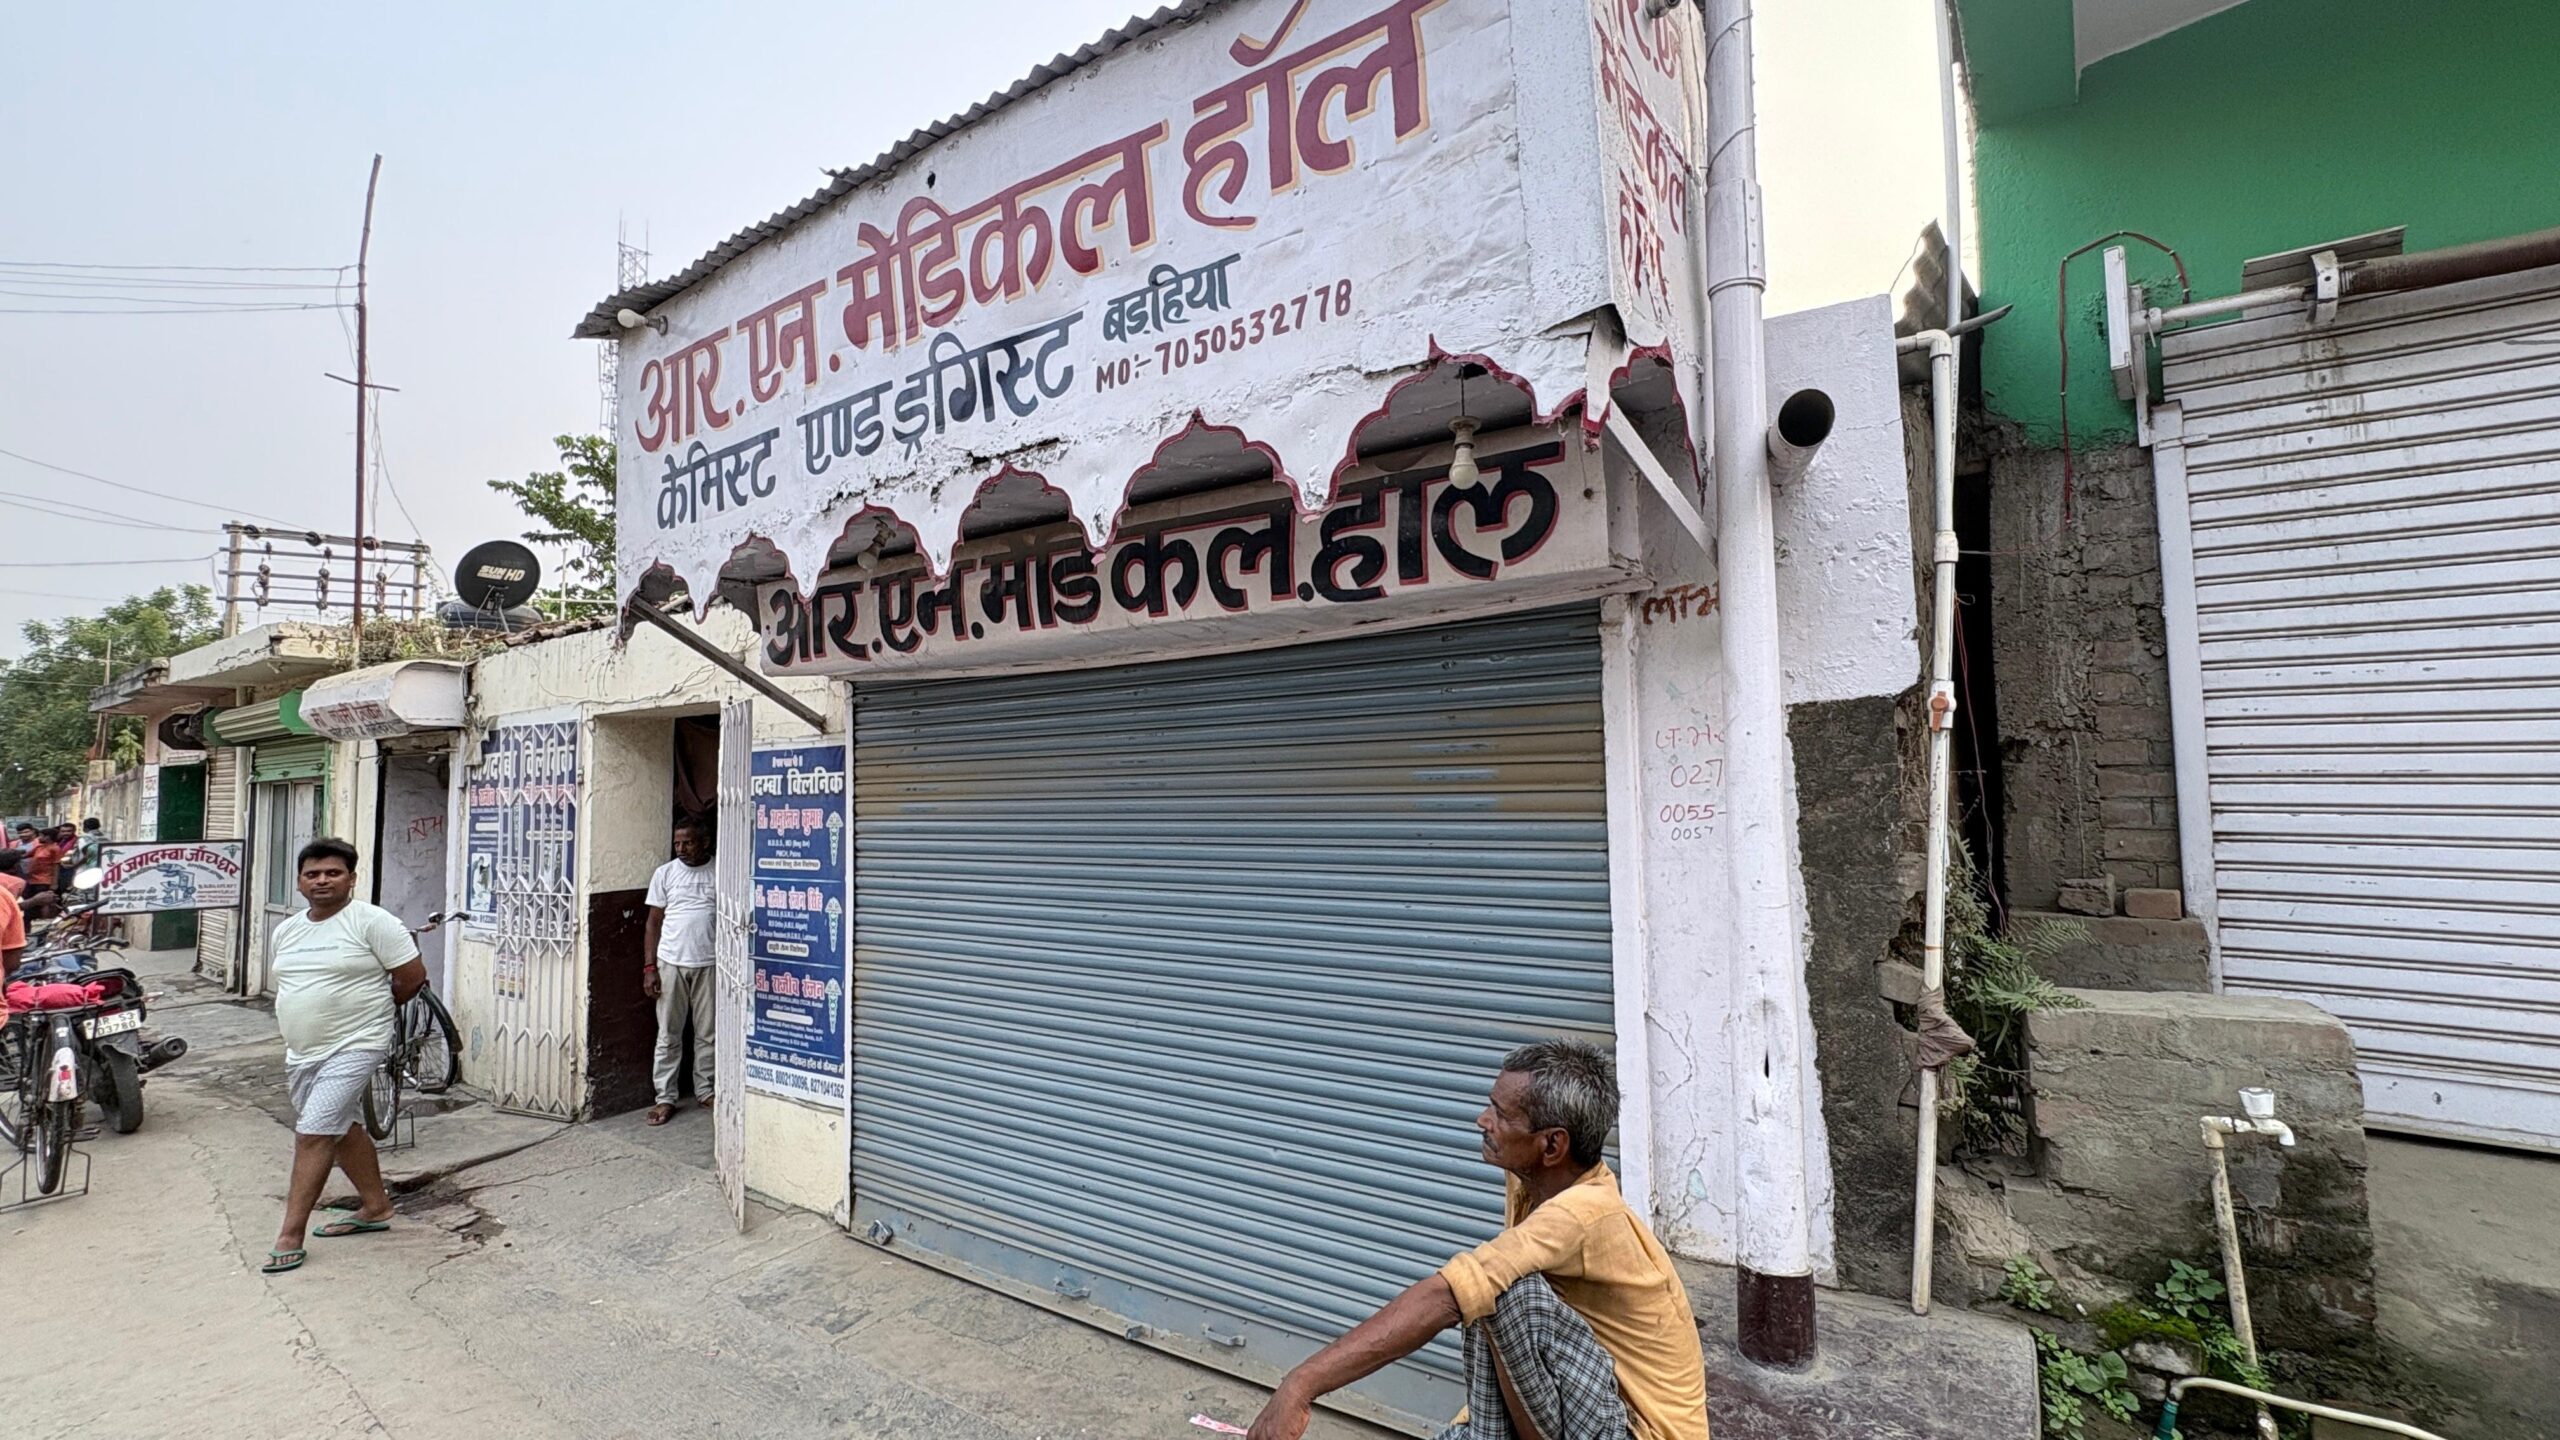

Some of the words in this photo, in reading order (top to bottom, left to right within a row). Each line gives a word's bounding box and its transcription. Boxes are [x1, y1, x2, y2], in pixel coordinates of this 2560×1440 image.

[1182, 0, 1452, 231] हॉल
[657, 427, 780, 530] केमिस्ट
[503, 568, 526, 581] HD
[750, 774, 783, 796] दम्बा
